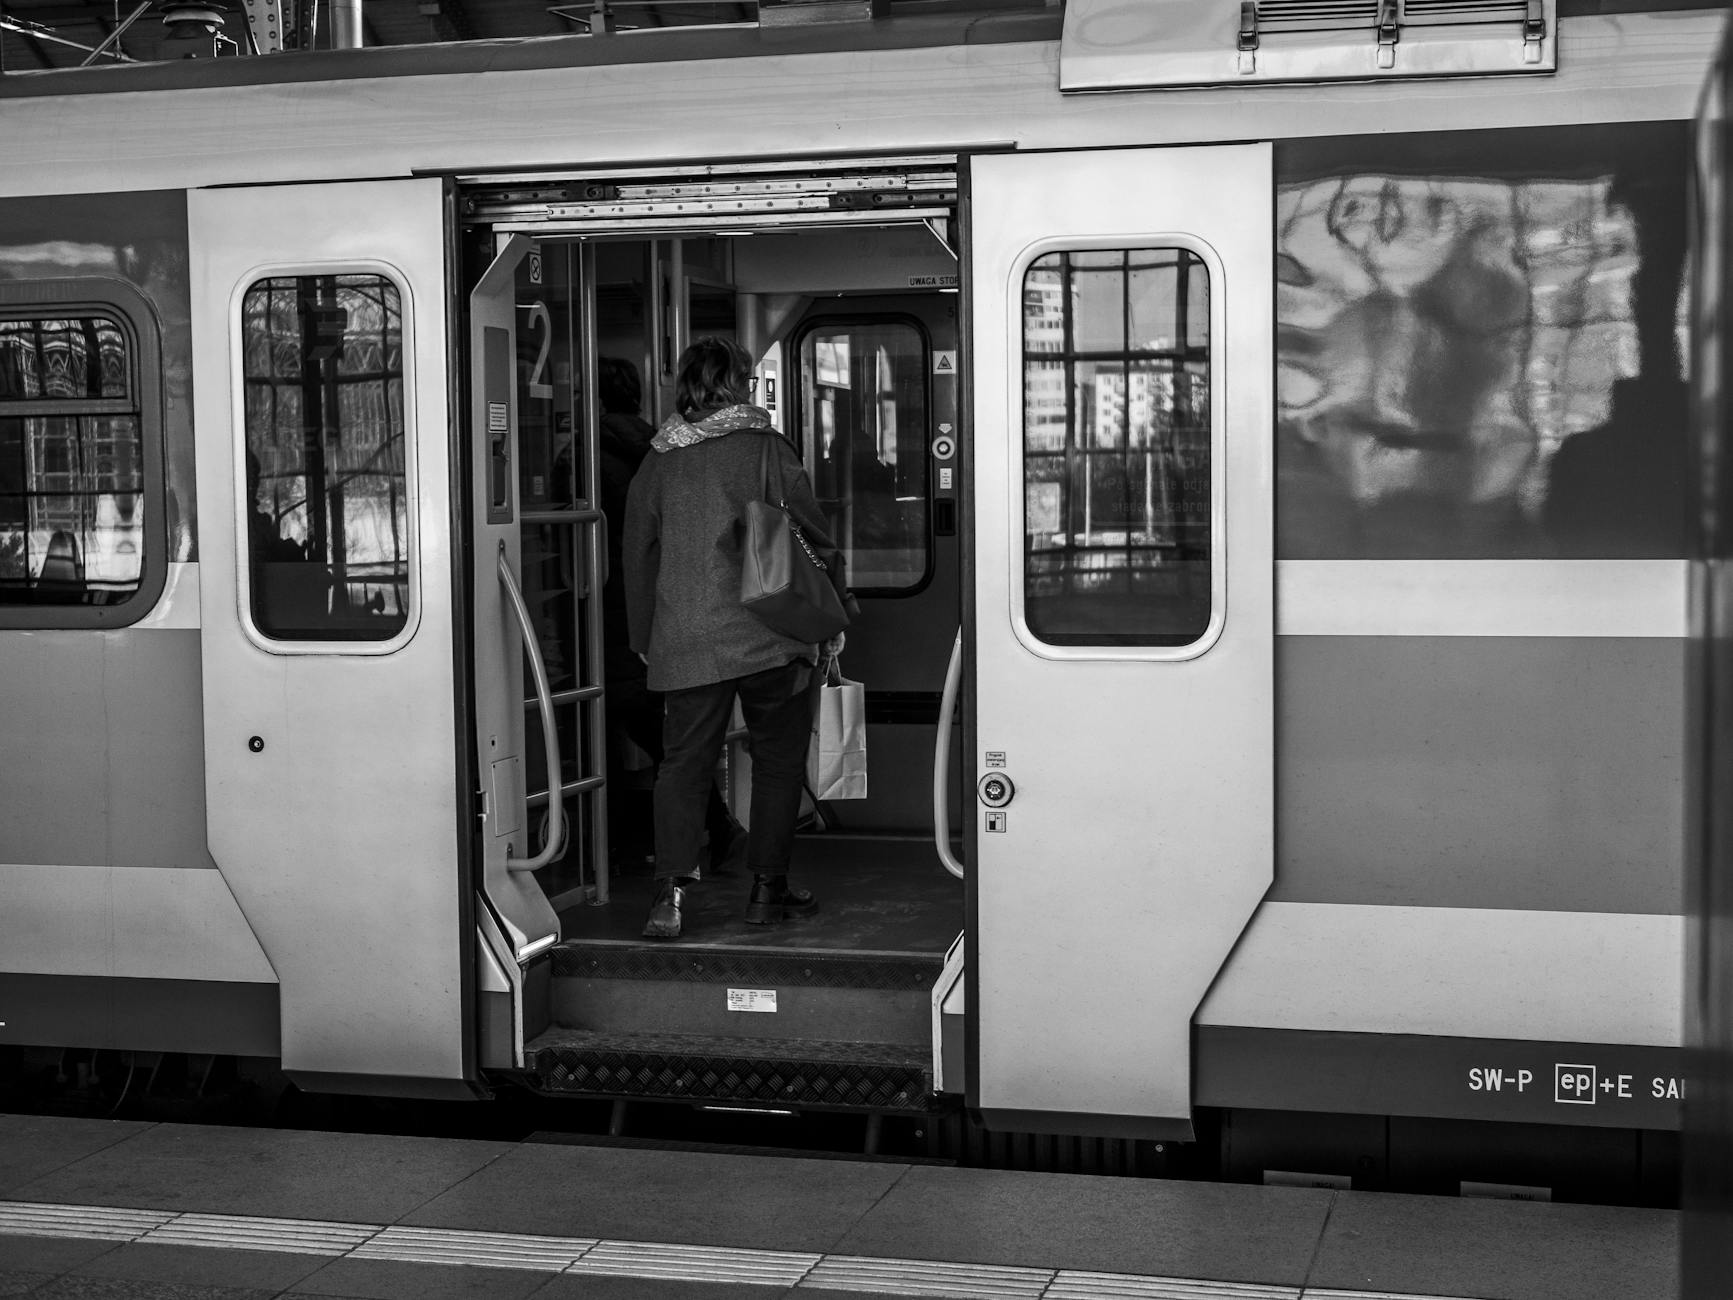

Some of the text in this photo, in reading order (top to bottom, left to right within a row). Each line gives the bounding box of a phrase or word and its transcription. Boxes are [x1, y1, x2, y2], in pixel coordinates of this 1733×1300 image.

[909, 277, 936, 286] UWAGA
[528, 300, 553, 399] 2
[1468, 1067, 1533, 1092] SW-P
